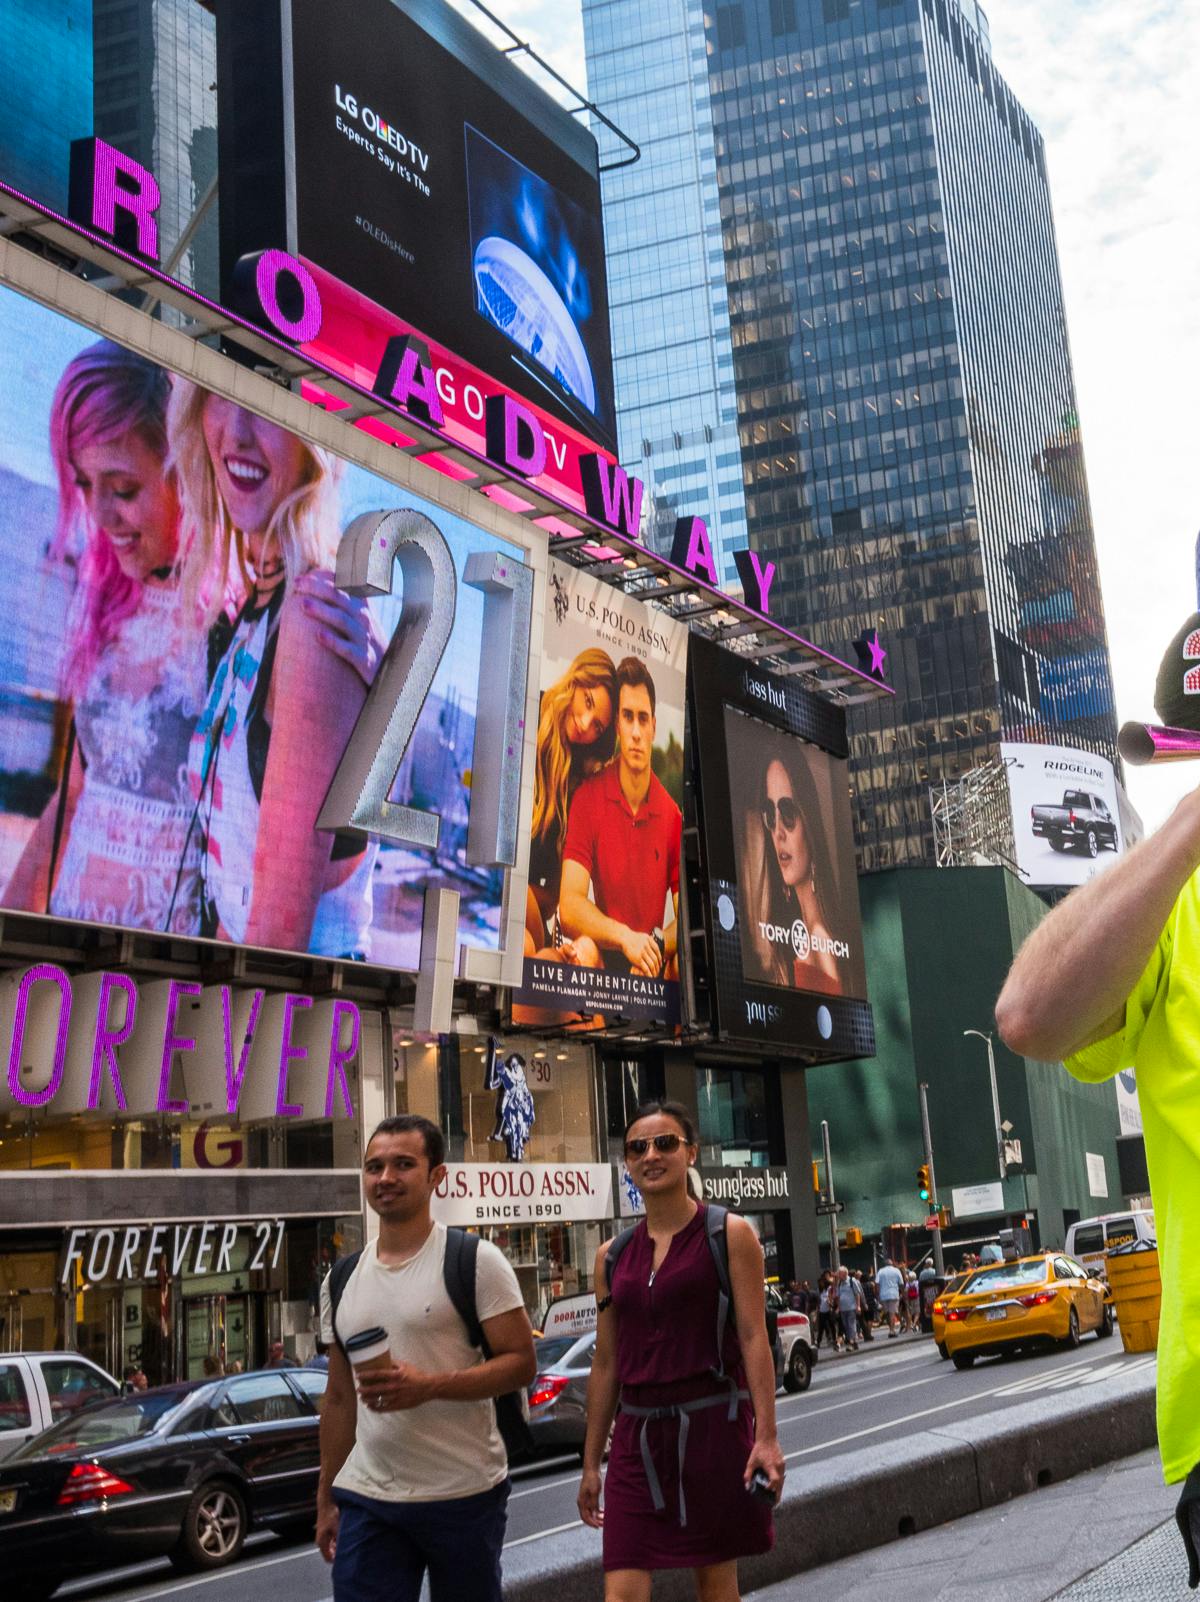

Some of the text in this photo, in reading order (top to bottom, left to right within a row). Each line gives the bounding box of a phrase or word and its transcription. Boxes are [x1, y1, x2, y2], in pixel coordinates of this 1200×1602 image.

[335, 84, 358, 118] LG
[336, 115, 431, 198] Experts Say It's The
[576, 595, 671, 654] U.S. POLO ASSN.
[596, 629, 648, 659] SINCE 1890
[767, 681, 787, 711] hut
[1044, 760, 1104, 780] RIDGELINE
[759, 922, 850, 959] TORY BURCH
[532, 983, 556, 993] PAMELA
[556, 986, 587, 997] FLANAGAN
[633, 996, 647, 1006] POLO
[533, 964, 665, 996] LIVE AUTHENTICALLY
[7, 962, 361, 1120] OREVER
[530, 1058, 551, 1082] $30
[478, 1170, 535, 1198] POLO
[540, 1170, 595, 1196] ASSN.
[705, 1168, 789, 1207] sunglass hut
[476, 1203, 562, 1218] SINCE 1890
[61, 1220, 285, 1284] FOREVER 21
